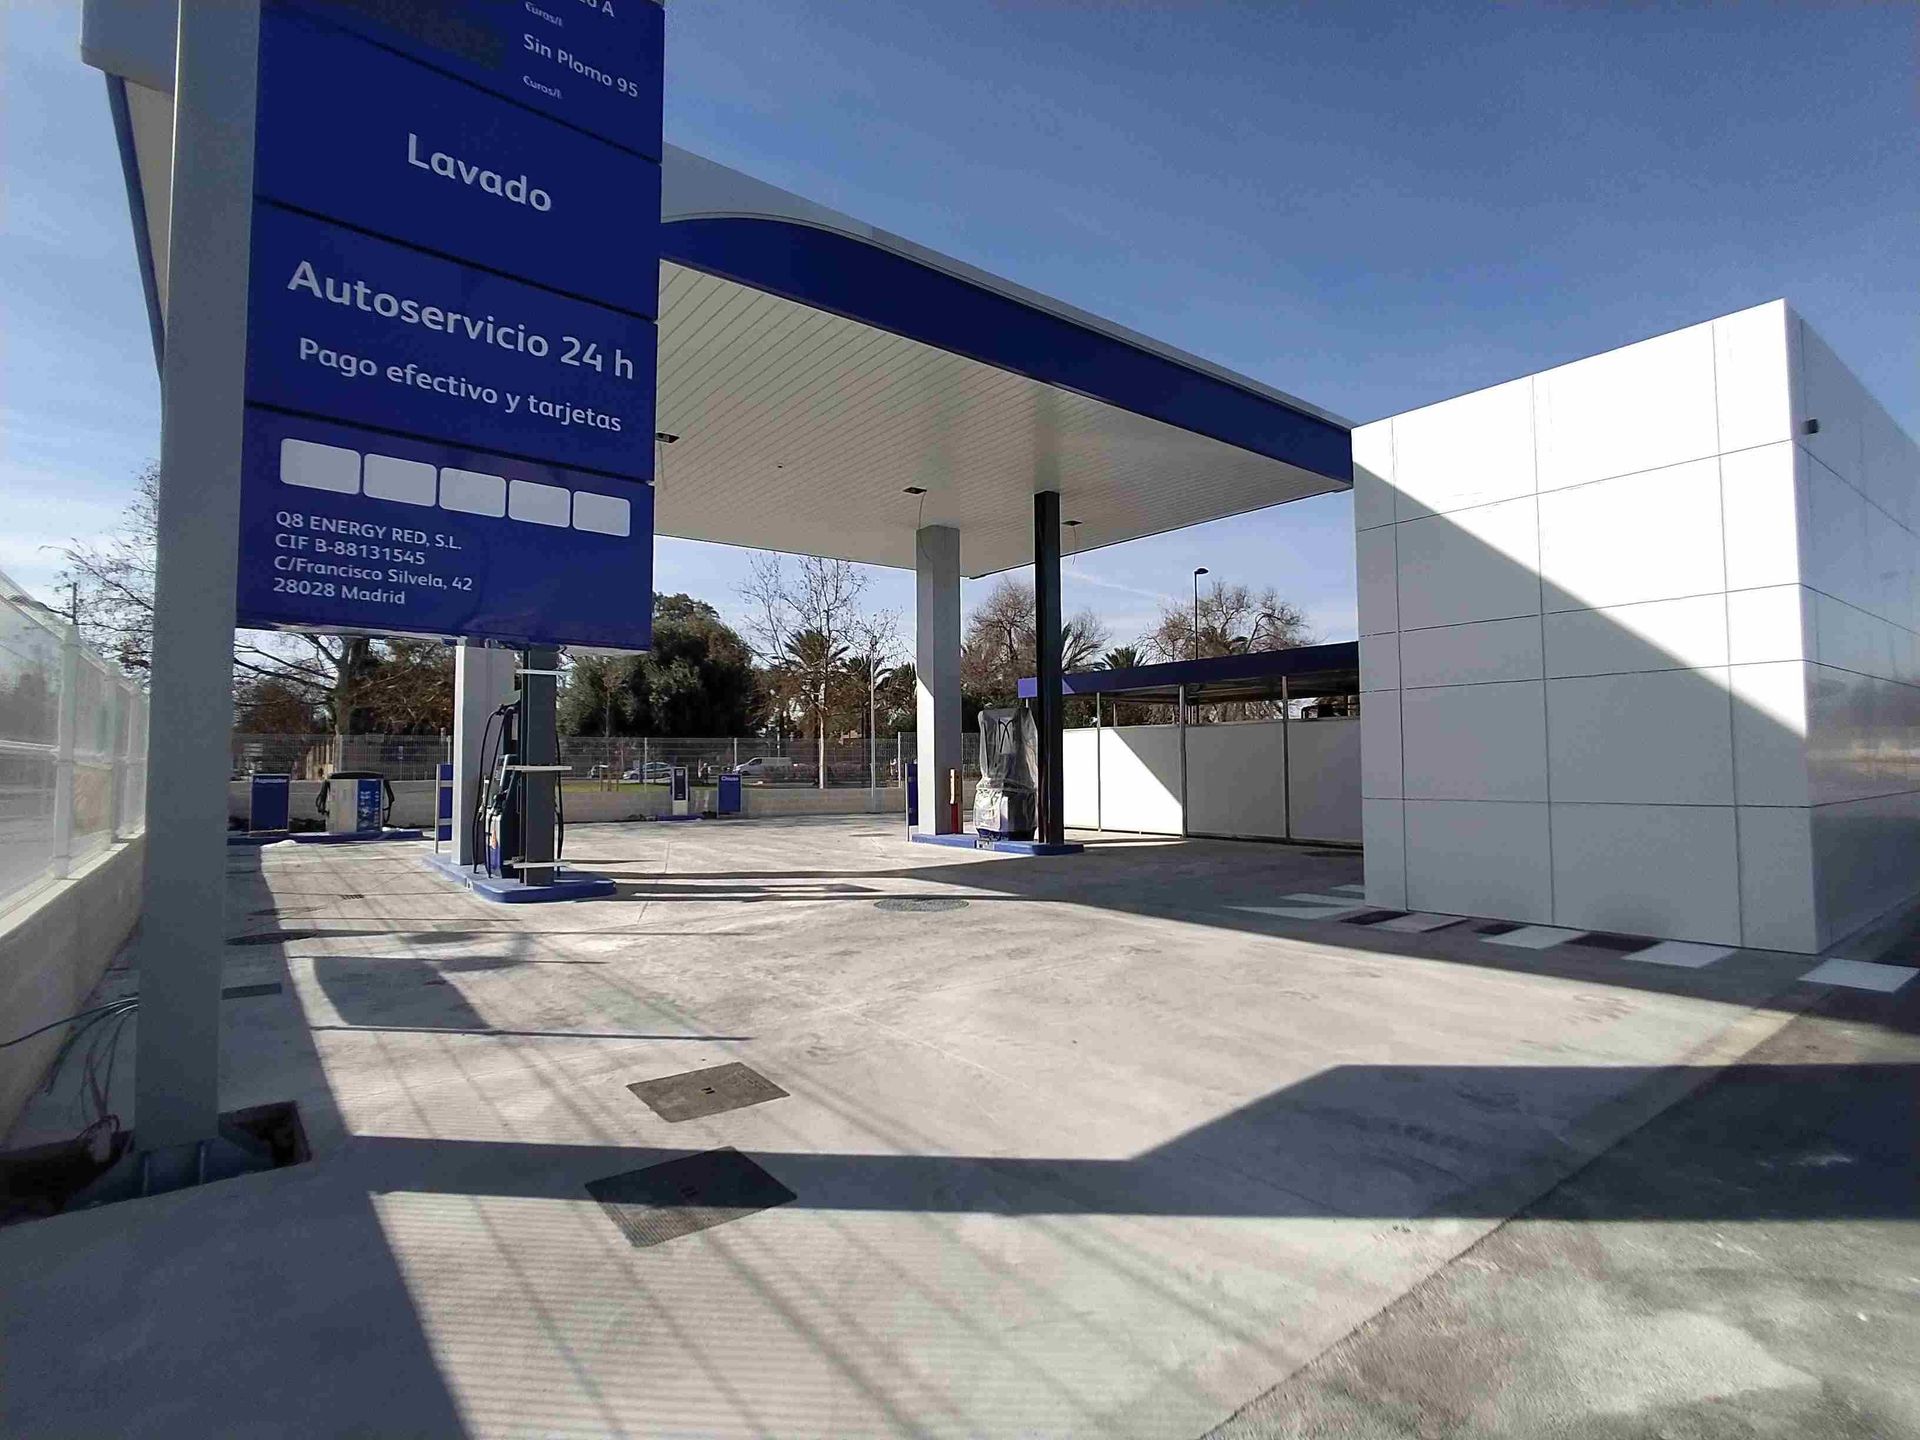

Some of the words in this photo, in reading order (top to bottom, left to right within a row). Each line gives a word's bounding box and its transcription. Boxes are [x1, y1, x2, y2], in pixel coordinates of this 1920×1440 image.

[524, 34, 551, 59] Sin
[557, 49, 612, 86] Plomo
[617, 77, 638, 97] 95
[408, 133, 552, 212] Lavado
[287, 261, 548, 358] Autoservicio
[561, 336, 602, 373] 24
[615, 348, 633, 380] h
[300, 338, 377, 377] Pago
[387, 364, 497, 404] efectivo
[505, 393, 520, 413] y
[528, 395, 622, 432] tarjetas
[275, 533, 309, 549] CIF
[315, 538, 425, 565] B-88131545
[276, 511, 304, 528] Q8
[310, 516, 386, 539] ENERGY
[392, 528, 430, 547] RED,
[434, 534, 462, 550] S.L.
[273, 577, 335, 597] 28028
[341, 585, 405, 605] Madrid
[274, 555, 382, 581] C/Francisco
[388, 569, 447, 590] Silvela,
[452, 577, 473, 591] 42
